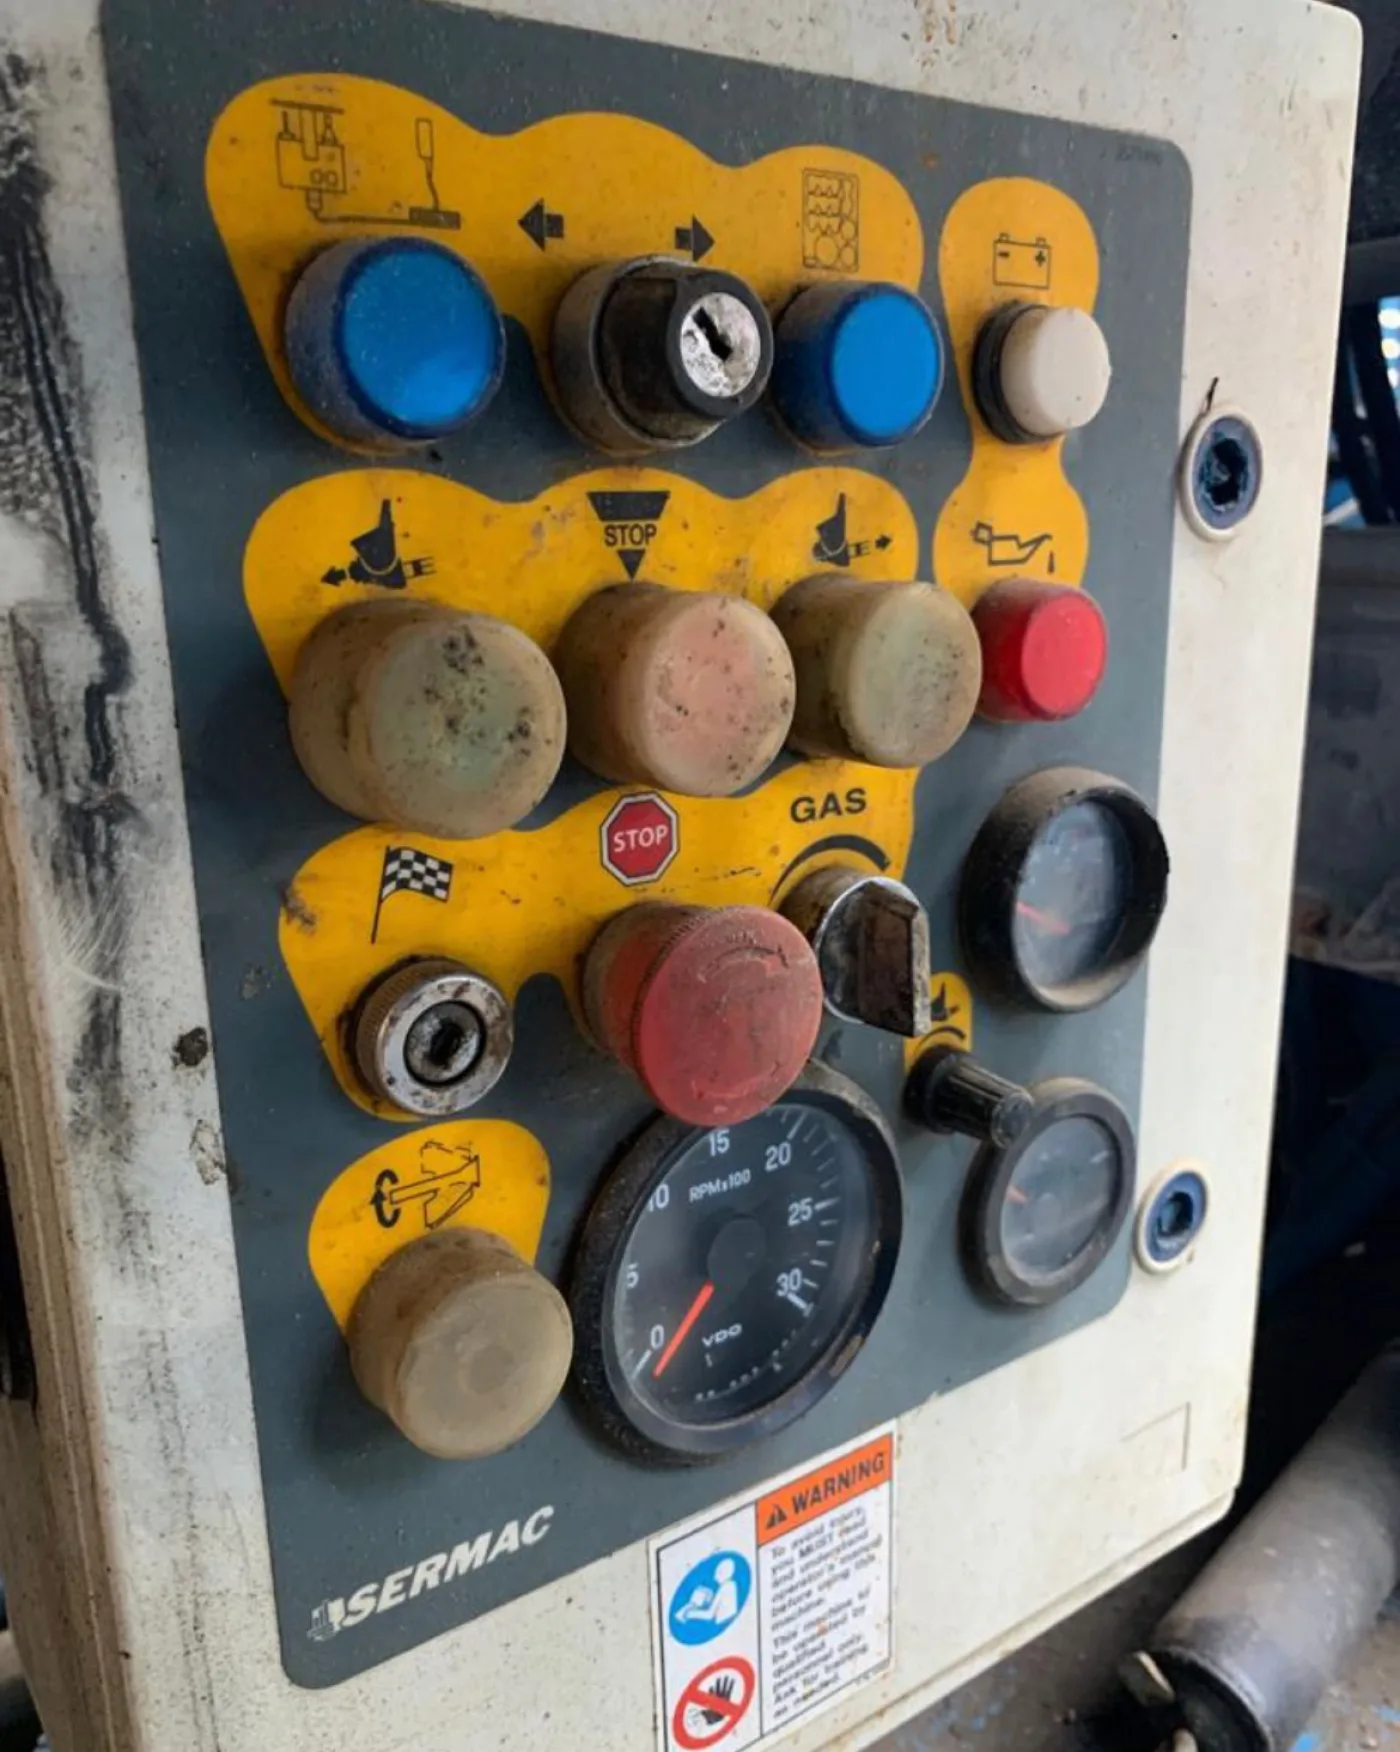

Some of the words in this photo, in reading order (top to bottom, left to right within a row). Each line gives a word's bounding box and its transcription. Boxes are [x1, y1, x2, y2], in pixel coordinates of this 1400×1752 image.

[604, 523, 657, 547] STOP
[790, 788, 867, 823] GAS
[613, 824, 669, 853] STOP
[708, 1128, 730, 1156] 15
[765, 1141, 791, 1172] 20
[788, 1197, 813, 1227] 25
[625, 1262, 639, 1290] 5
[776, 1266, 803, 1297] 30
[650, 1323, 665, 1350] 0
[701, 1323, 742, 1348] VDO
[792, 1451, 885, 1515] WARNING
[341, 1504, 555, 1628] SERMAC
